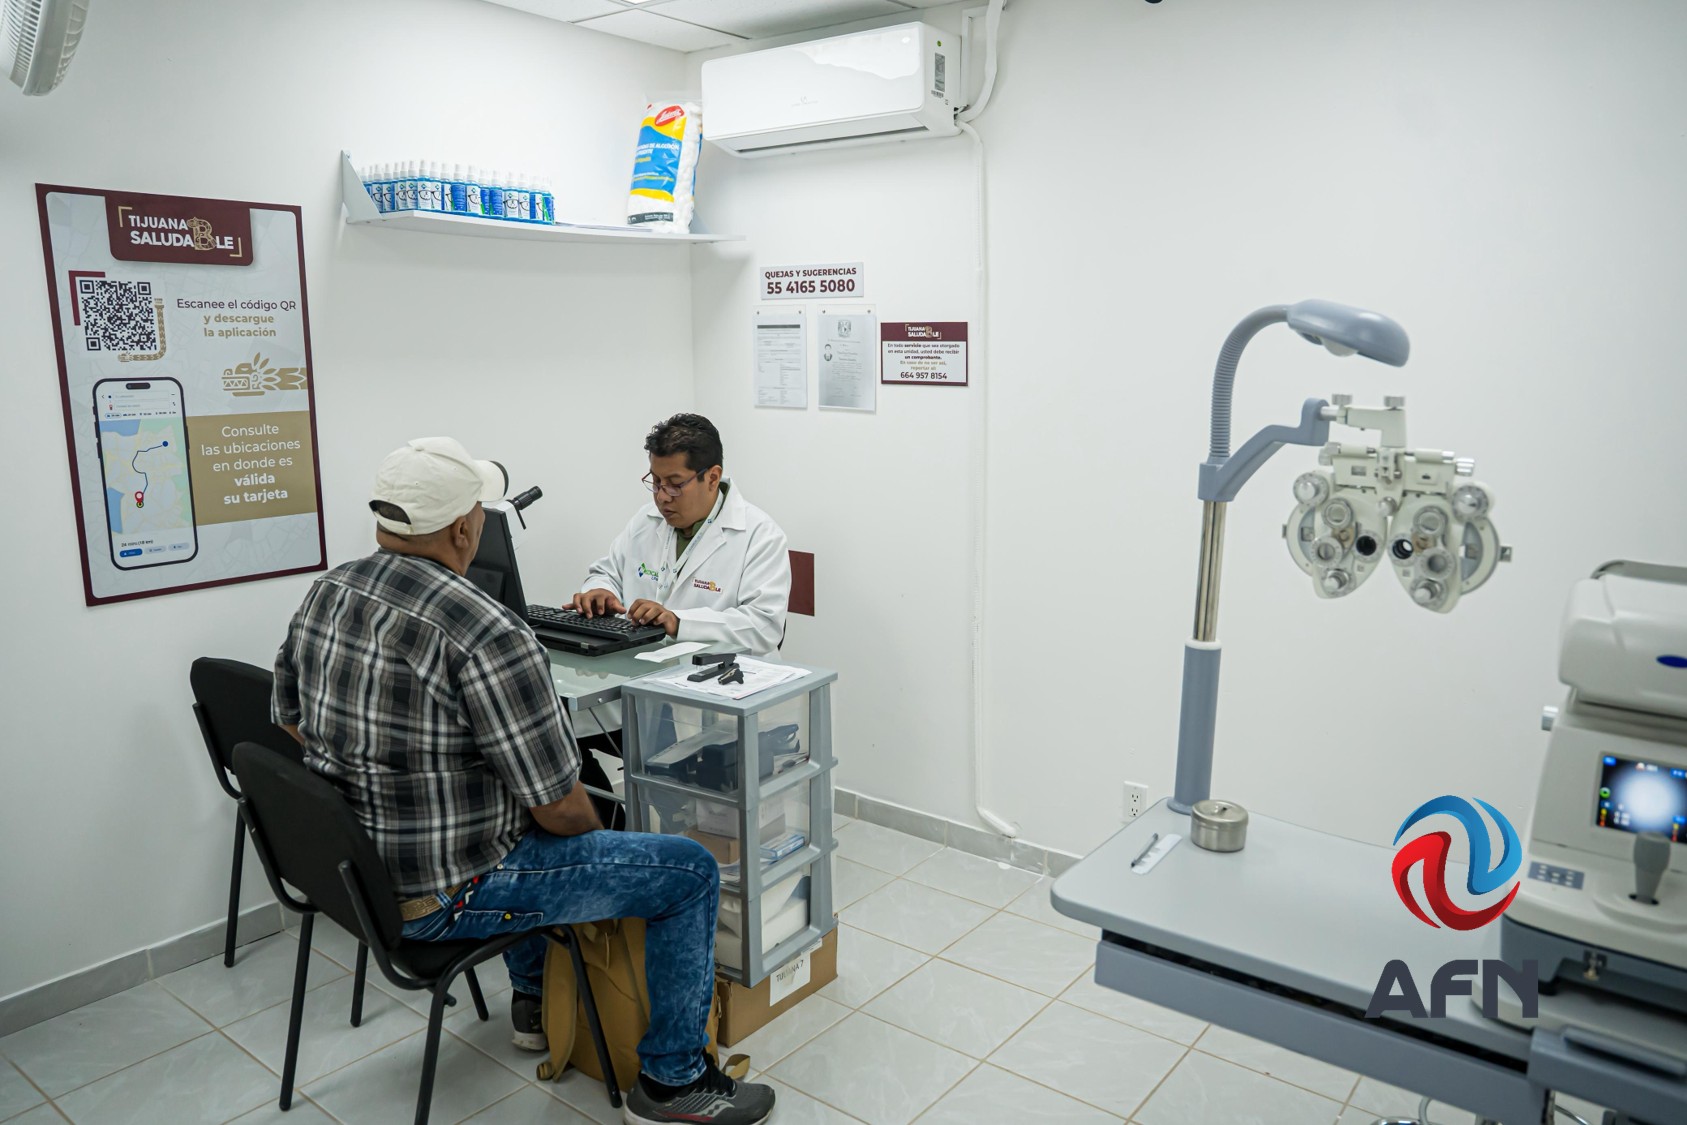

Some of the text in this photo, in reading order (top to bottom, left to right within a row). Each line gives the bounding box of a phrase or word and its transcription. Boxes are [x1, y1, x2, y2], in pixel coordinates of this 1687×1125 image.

[128, 215, 188, 230] TIJUANA
[130, 217, 234, 250] SALUDABLE
[764, 270, 794, 279] QUEJAS
[802, 267, 857, 277] SUGERENCIAS
[767, 279, 855, 294] 55 4165 5080
[177, 298, 296, 313] Escanee el código QR
[204, 313, 274, 327] y descargue
[204, 327, 276, 340] la aplicación
[930, 372, 947, 380] 8154
[221, 424, 279, 438] Consulte
[201, 439, 301, 456] las ubicaciones
[212, 457, 293, 472] en donde es
[234, 473, 276, 487] válida
[223, 489, 288, 505] su tarjeta
